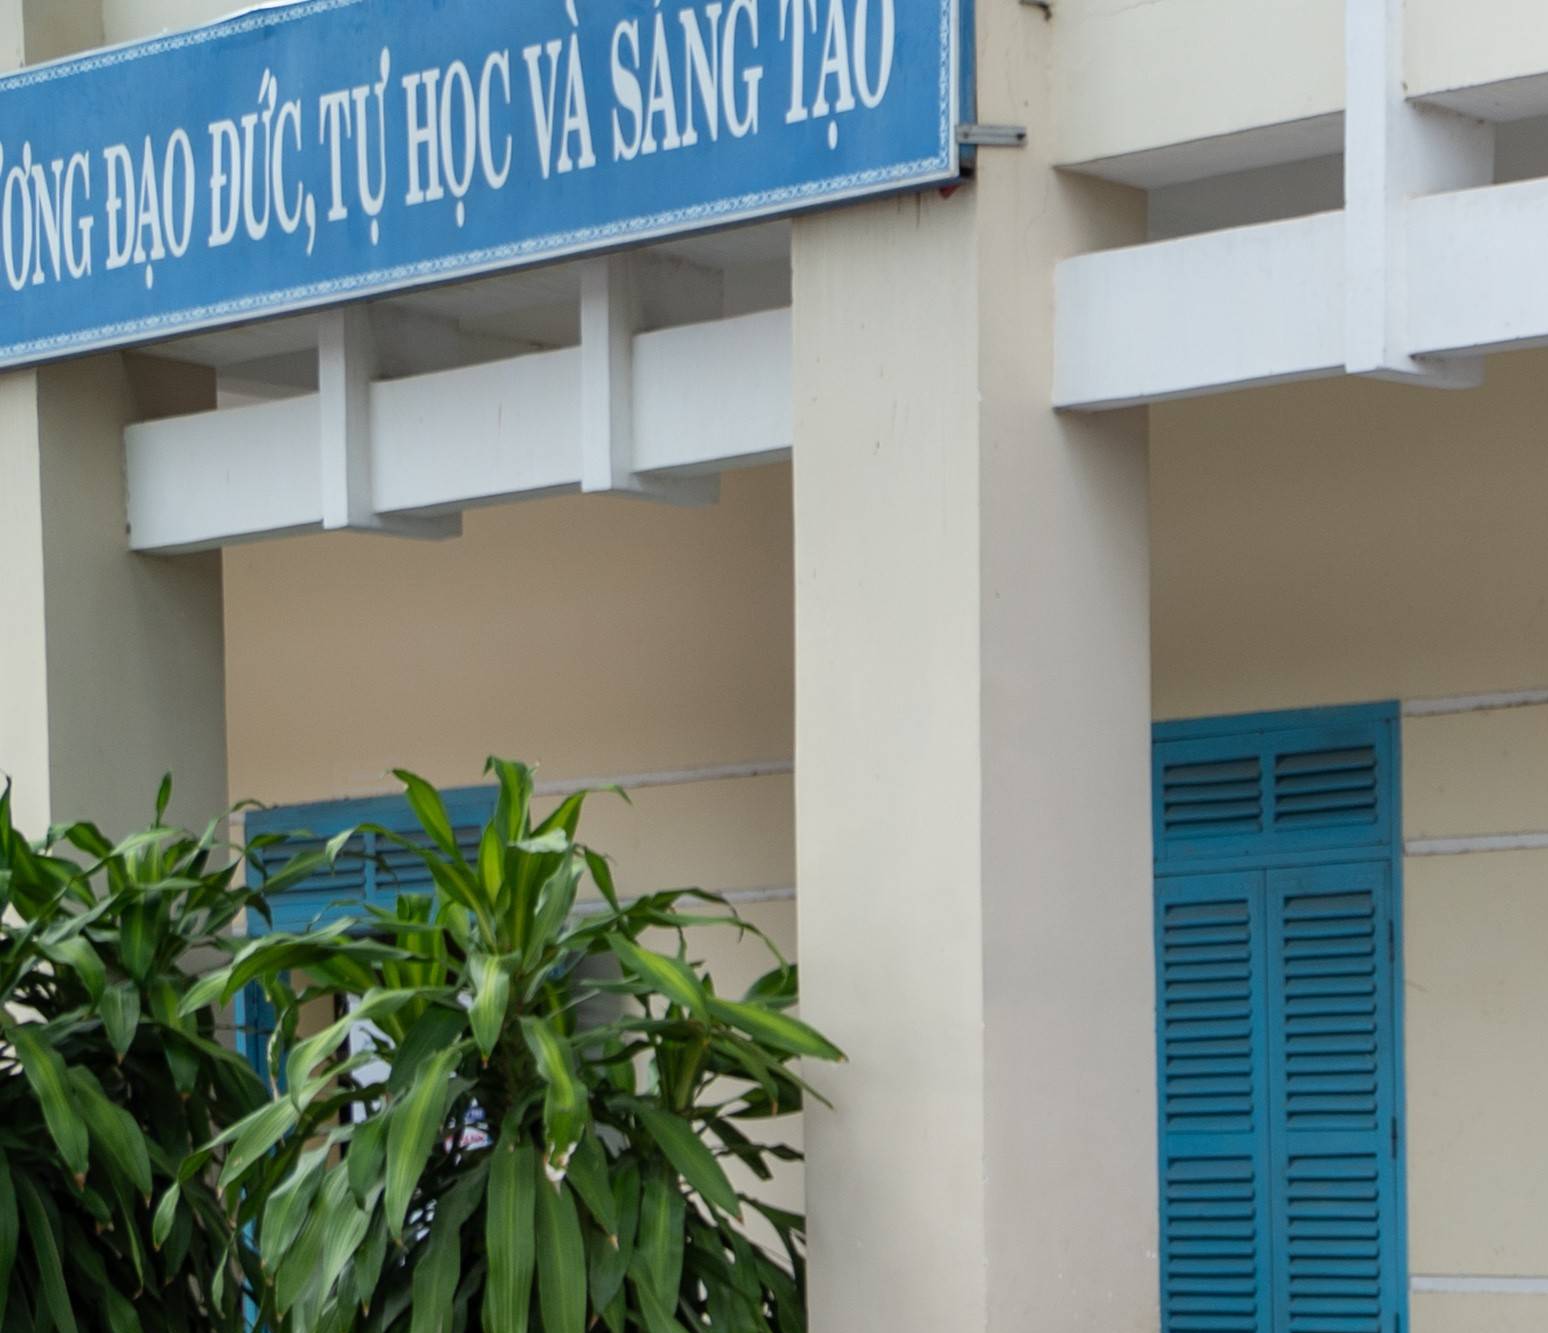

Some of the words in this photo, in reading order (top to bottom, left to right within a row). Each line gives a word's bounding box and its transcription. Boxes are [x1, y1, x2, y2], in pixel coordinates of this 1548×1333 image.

[0, 141, 94, 290] ƠNG
[103, 128, 195, 290] ĐẠO
[208, 69, 317, 255] ĐỨC,
[320, 47, 390, 247] TỰ
[402, 50, 513, 228] HỌC
[522, 0, 597, 174] VÀ
[611, 0, 763, 161] SÁNG
[781, 0, 896, 150] TẠO
